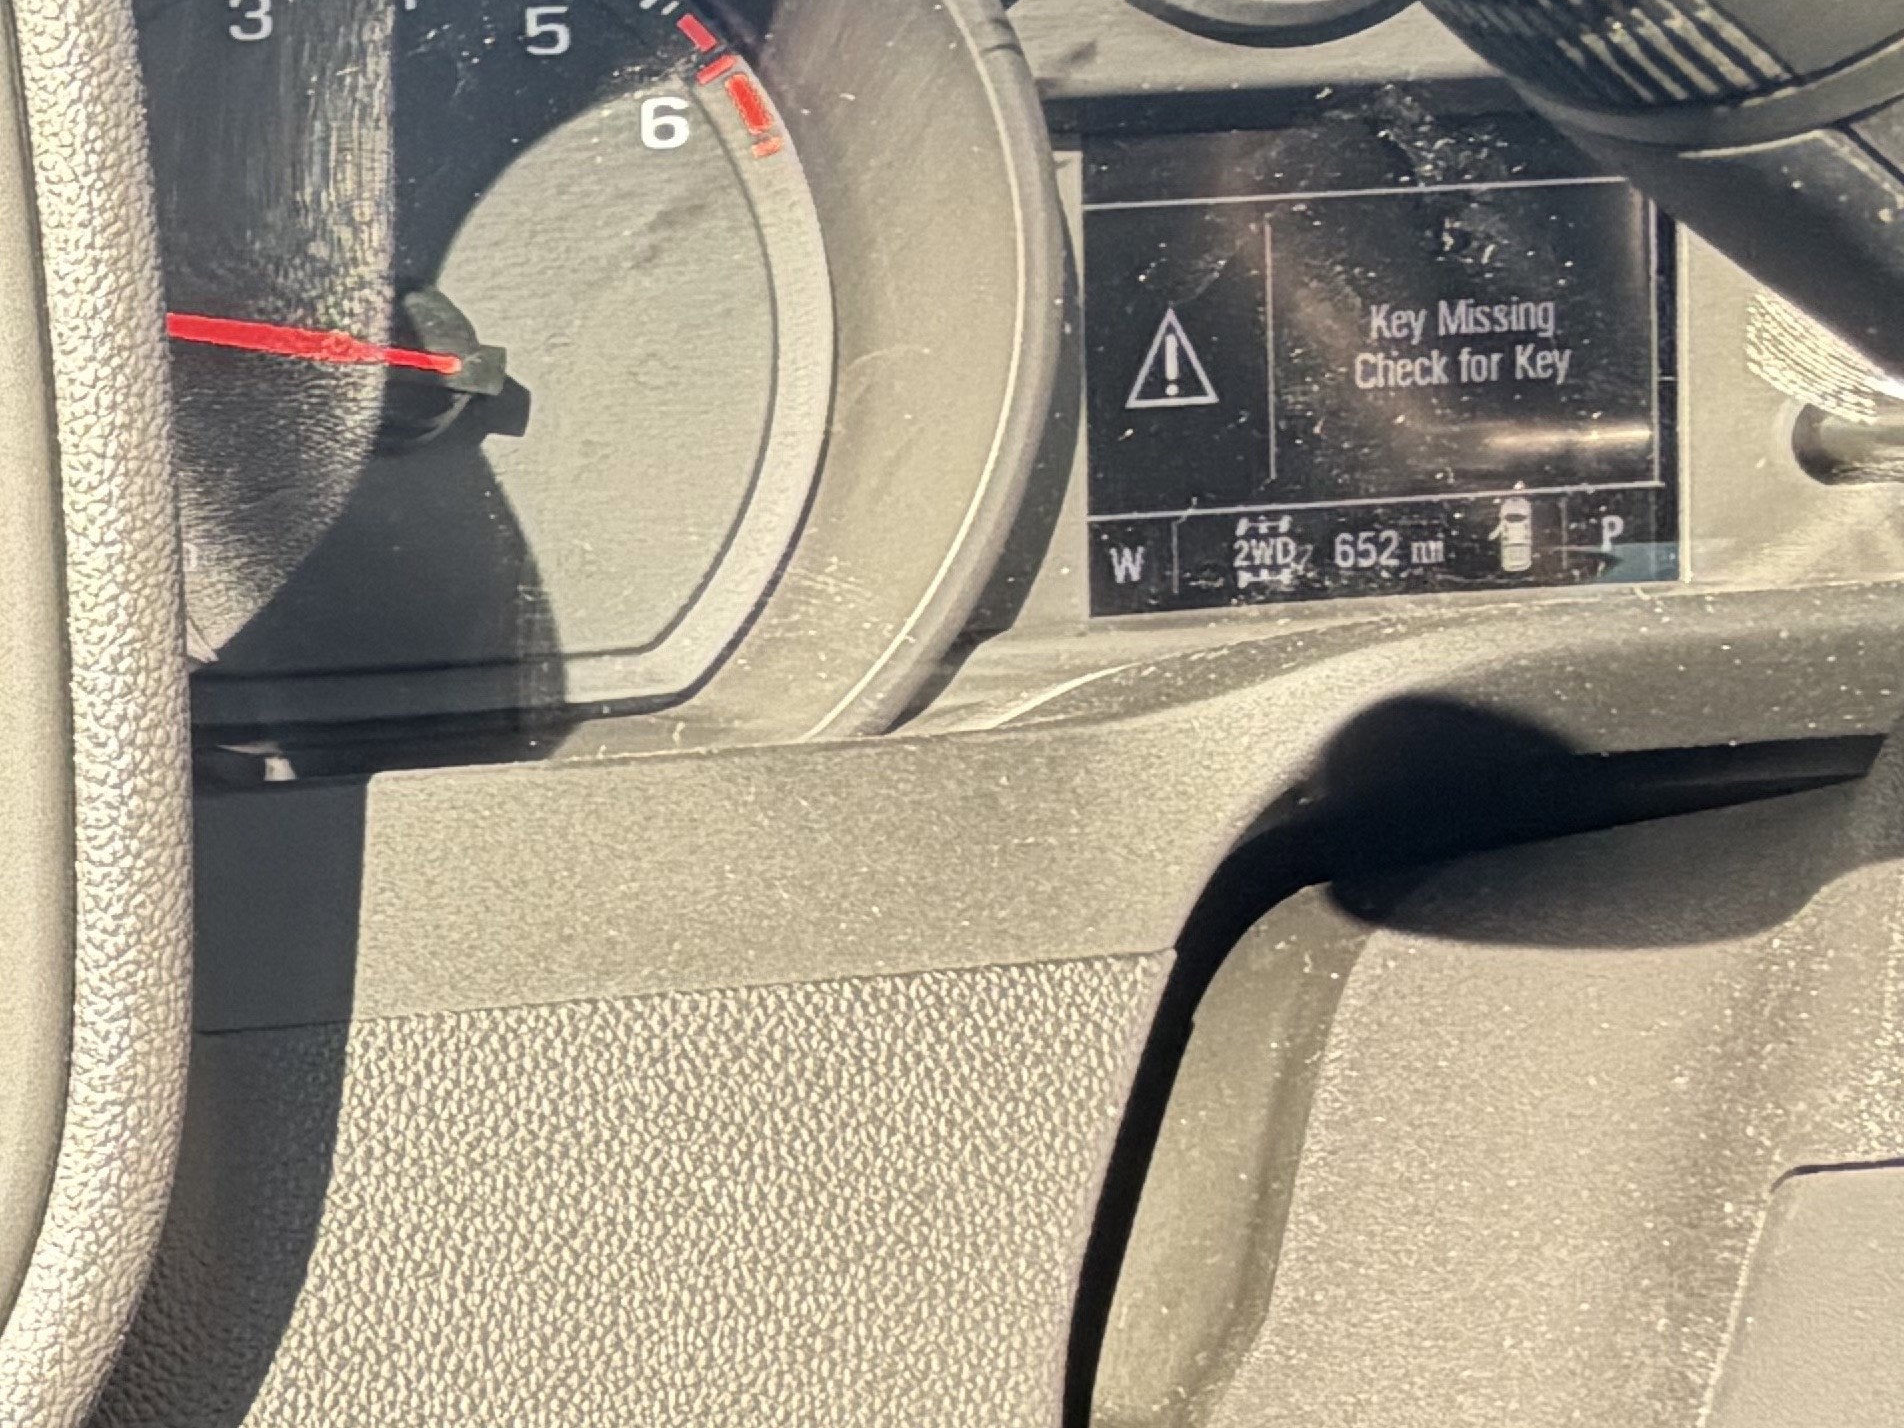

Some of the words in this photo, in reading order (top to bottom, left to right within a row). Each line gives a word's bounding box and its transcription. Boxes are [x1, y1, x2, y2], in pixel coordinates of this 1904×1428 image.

[524, 6, 571, 55] 5
[639, 97, 690, 150] 6
[1369, 302, 1427, 346] Key
[1438, 298, 1555, 338] Missing
[1354, 349, 1450, 389] Check
[1459, 347, 1504, 383] for
[1514, 343, 1573, 386] Key
[1334, 529, 1399, 568] 652
[1601, 513, 1624, 550] P
[1110, 546, 1144, 584] W
[1233, 538, 1295, 569] 2WD
